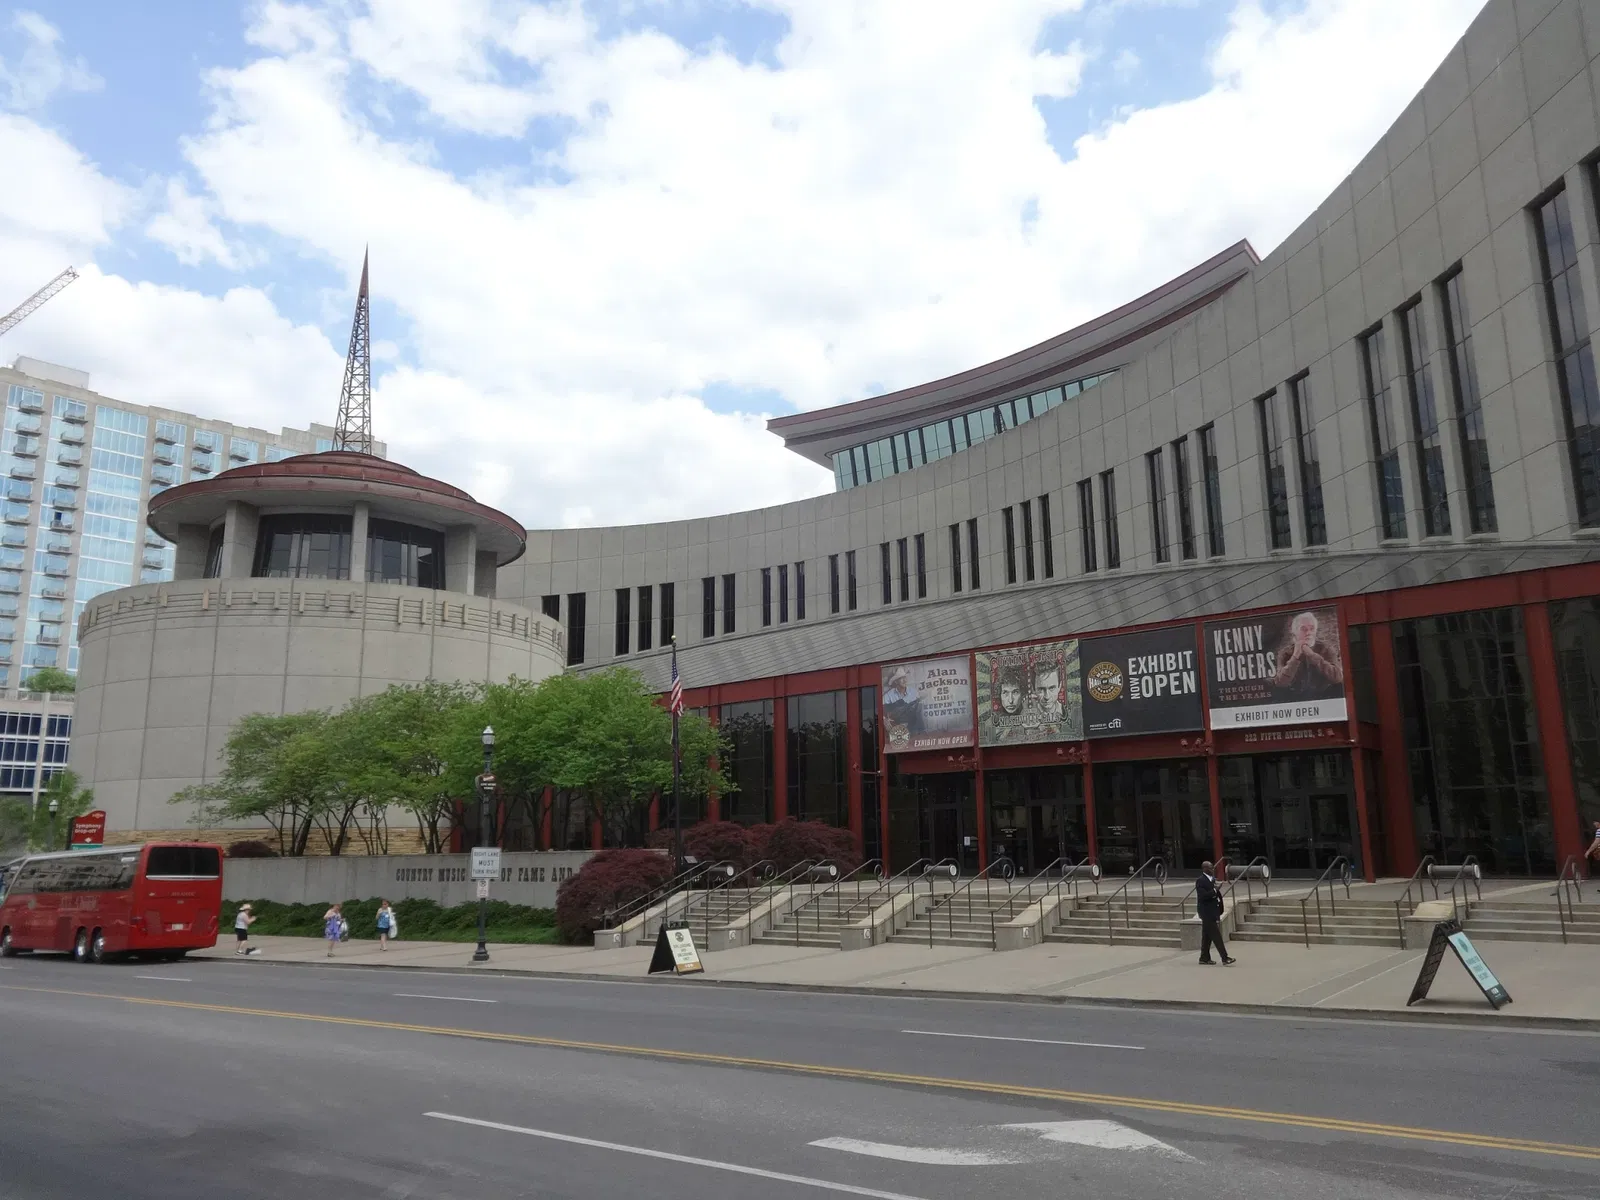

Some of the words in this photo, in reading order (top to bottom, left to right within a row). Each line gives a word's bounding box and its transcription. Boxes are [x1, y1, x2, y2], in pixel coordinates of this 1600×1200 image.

[1213, 625, 1263, 655] KENNY
[1128, 650, 1193, 676] EXHIBIT
[1216, 652, 1277, 682] ROGERS
[927, 668, 957, 679] Alan
[1096, 669, 1114, 678] MUSIC
[918, 678, 968, 692] Jackson
[1129, 677, 1141, 700] NOW
[1141, 670, 1196, 698] OPEN
[1218, 684, 1265, 694] THROUGH
[936, 687, 949, 695] 25
[1219, 694, 1238, 702] THE
[1241, 692, 1272, 700] YEARS
[923, 702, 955, 710] KEEPIN'
[923, 707, 967, 718] COUNTRY
[1235, 710, 1269, 722] EXHIBIT
[1272, 709, 1292, 719] NOW
[1295, 707, 1320, 718] OPEN
[1108, 718, 1122, 729] citi
[914, 738, 937, 748] EXHIBIT
[938, 737, 951, 745] NOW
[951, 735, 968, 744] OPEN
[1244, 734, 1257, 742] 222
[1260, 731, 1282, 741] FIFTH
[478, 859, 494, 867] MUST
[395, 868, 434, 882] COUNTRY
[438, 867, 466, 882] MUSIC
[501, 867, 513, 882] OF
[517, 867, 545, 883] FAME
[551, 866, 573, 882] AND
